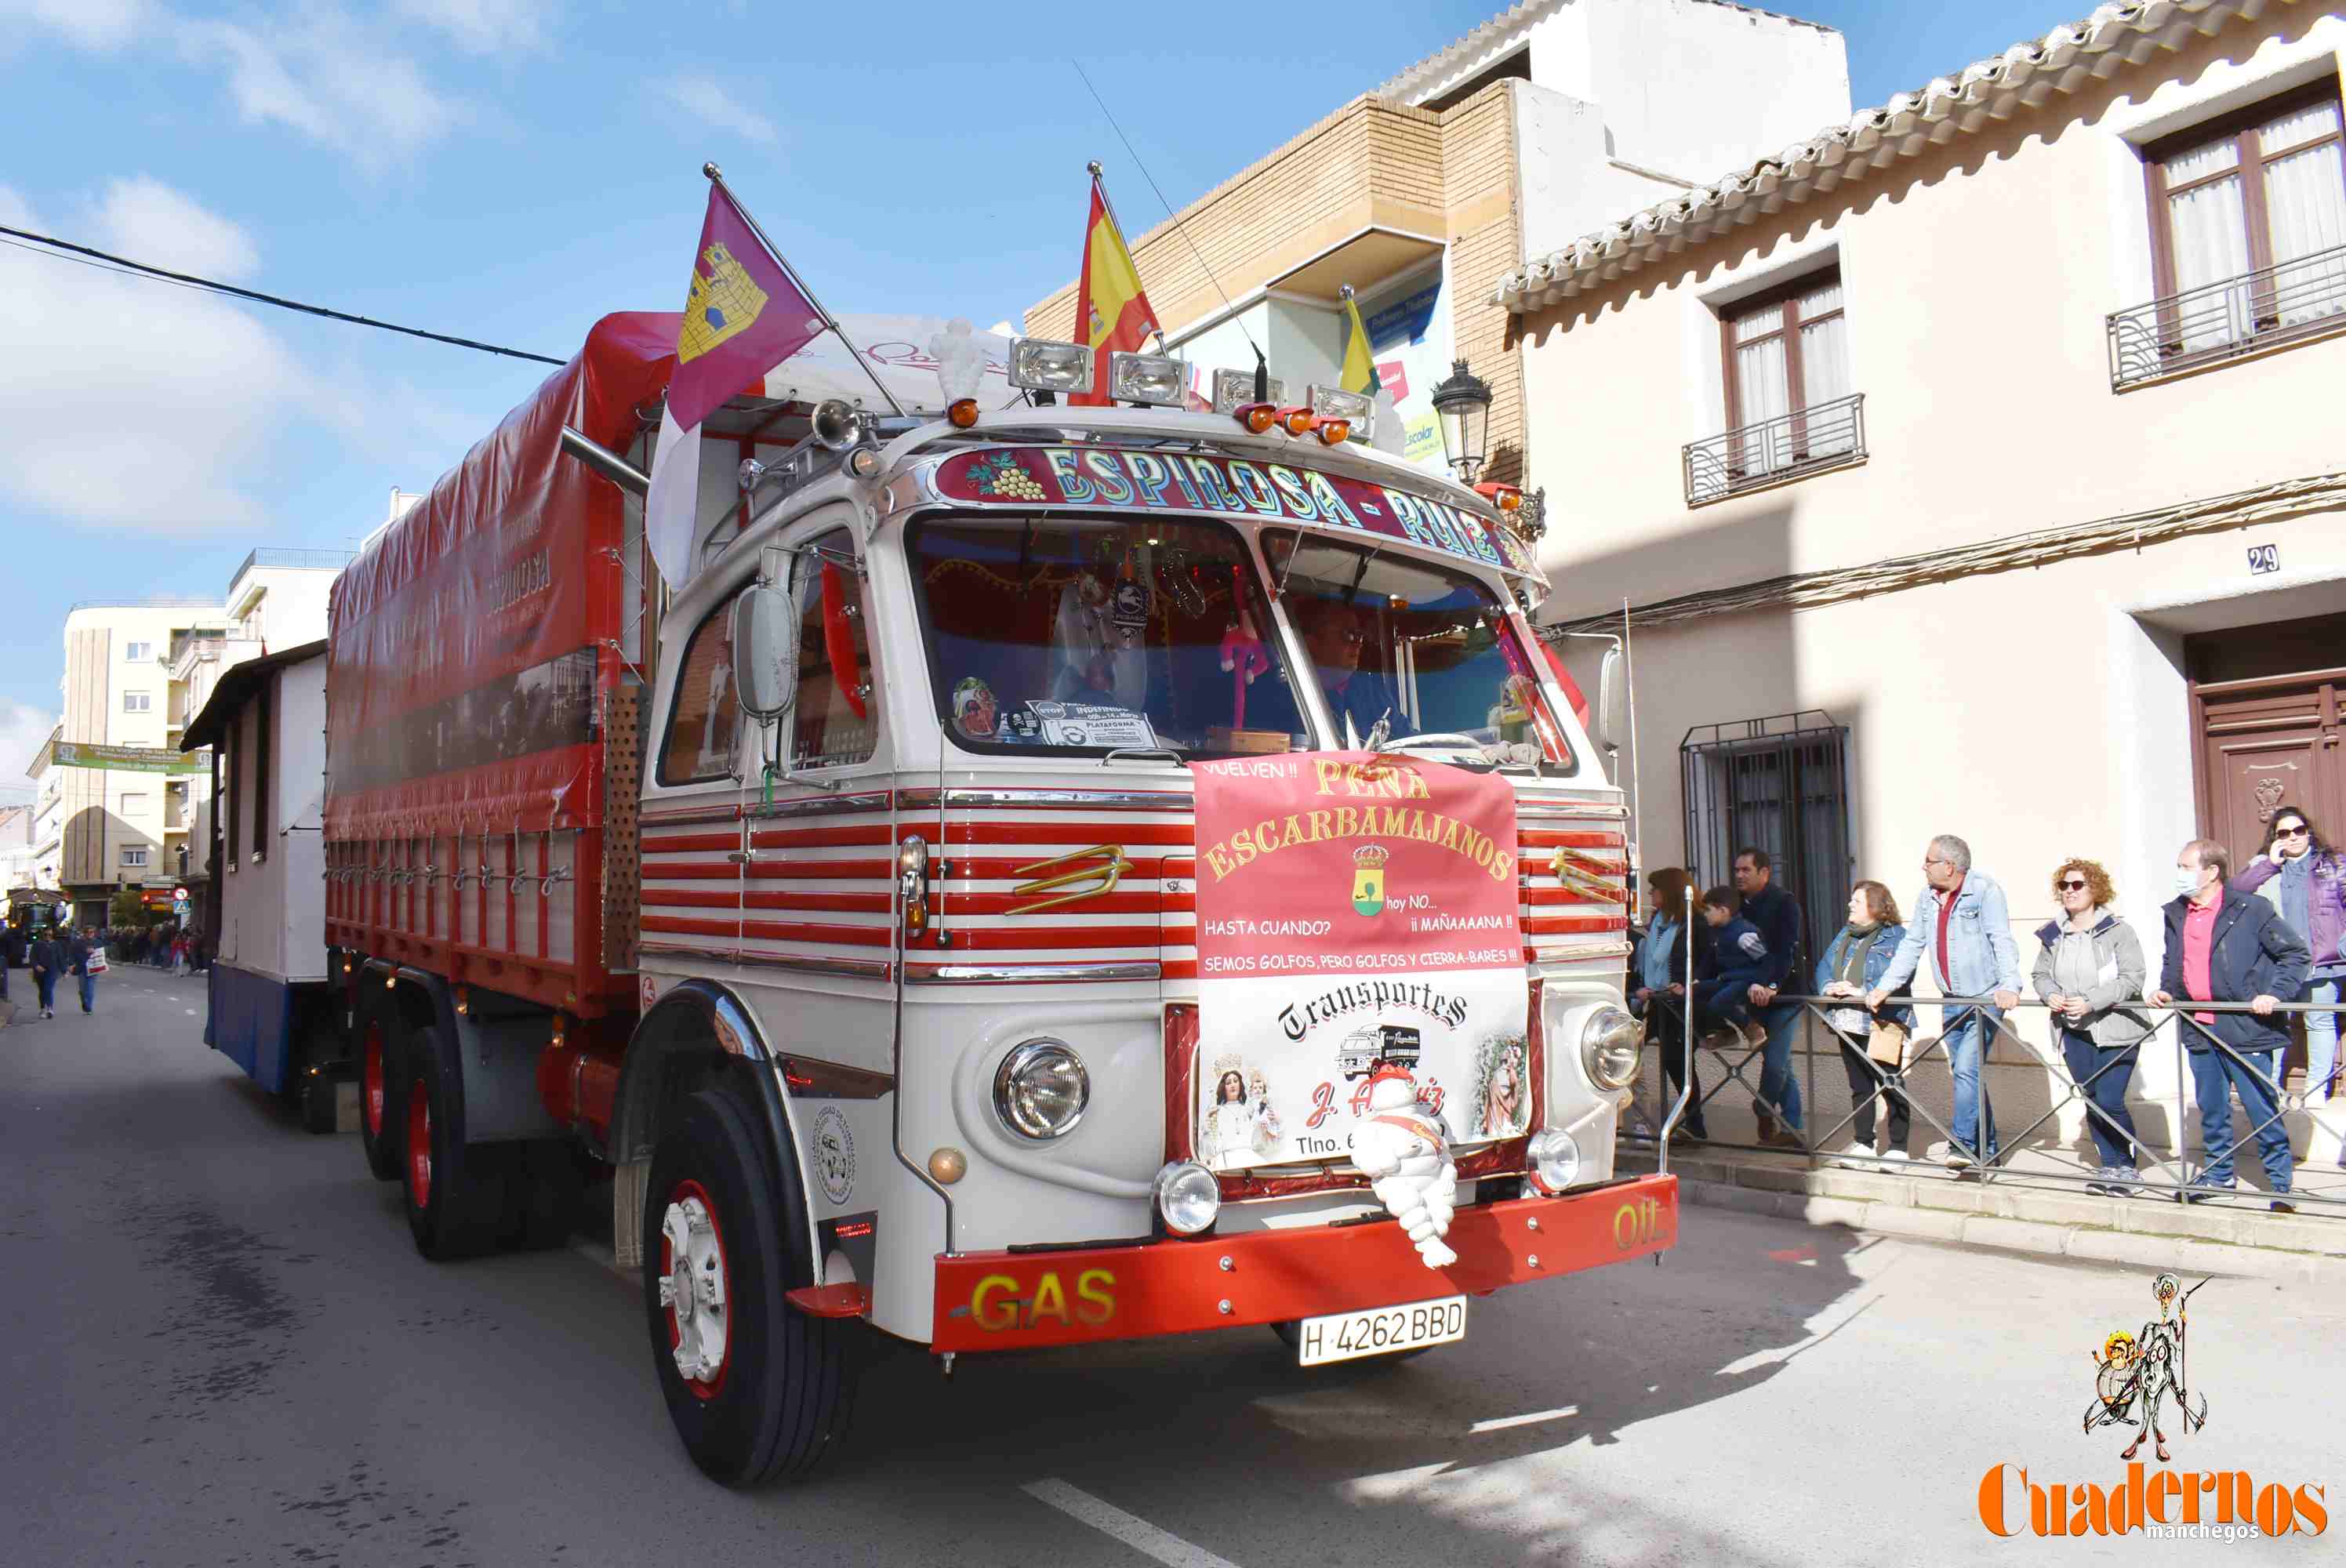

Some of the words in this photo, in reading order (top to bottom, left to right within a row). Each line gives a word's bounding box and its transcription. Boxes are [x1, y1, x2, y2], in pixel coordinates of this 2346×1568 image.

[1042, 449, 1363, 529] ESPINOSA
[1383, 488, 1502, 566] RUIZ
[2250, 546, 2279, 574] 29
[1203, 762, 1284, 779] VUELVEN
[1313, 757, 1431, 799] PEÑA
[1202, 805, 1514, 884] ESCARBAMAJANOS
[1385, 895, 1406, 910] hoy
[1409, 895, 1437, 909] NO...
[1204, 920, 1256, 935] HASTA
[1259, 920, 1331, 935] CUANDO?
[1420, 912, 1504, 931] MAÑAAAANA
[1204, 956, 1255, 972] SEMOS
[1320, 954, 1353, 969] PERO
[1356, 953, 1407, 969] GOLFOS
[1409, 953, 1417, 967] Y
[1420, 949, 1508, 966] CIERRA-BARES
[1277, 980, 1469, 1042] Transportes
[1306, 1081, 1337, 1128] J.
[1416, 1076, 1444, 1116] uiz
[1295, 1136, 1342, 1155] Tlno.
[1614, 1196, 1669, 1252] OIL
[971, 1268, 1117, 1333] GAS
